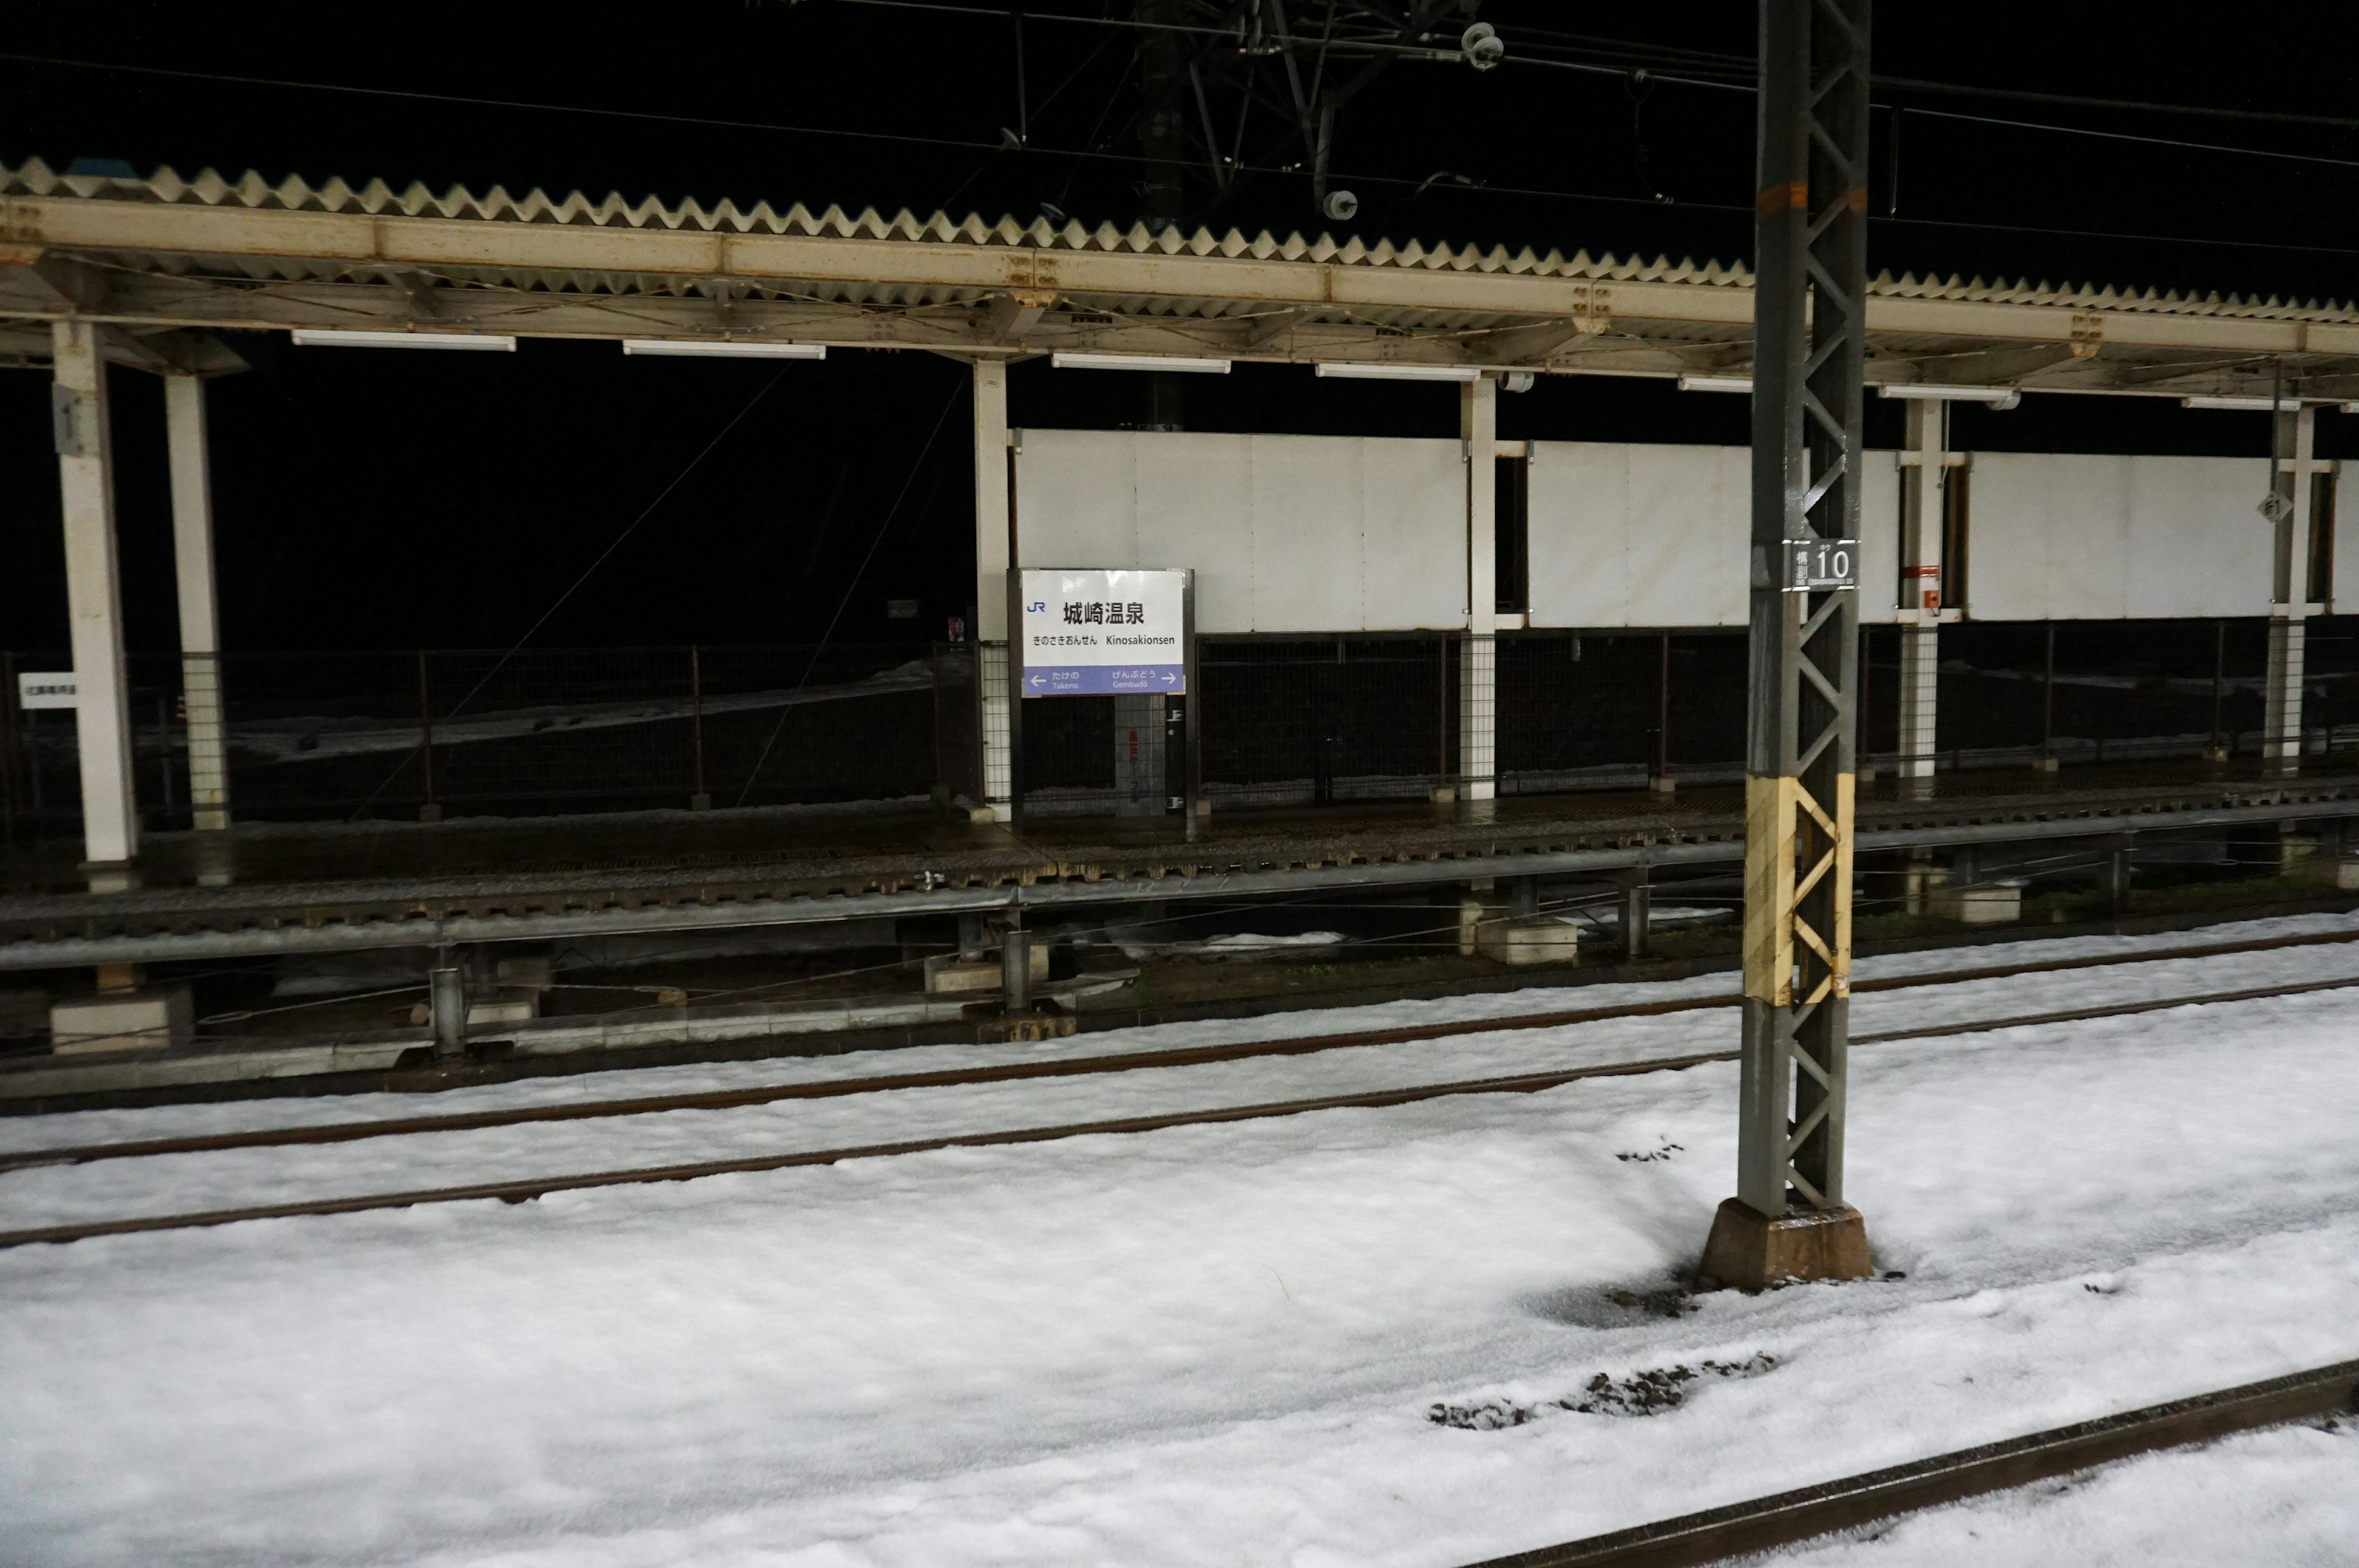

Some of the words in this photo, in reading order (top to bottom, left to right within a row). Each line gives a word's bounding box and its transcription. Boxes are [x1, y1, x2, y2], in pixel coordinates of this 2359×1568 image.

[1818, 551, 1849, 578] 10
[1027, 602, 1046, 612] JR
[1063, 602, 1144, 625] 城崎温泉
[1033, 635, 1098, 646] きのさきおんせん
[1106, 634, 1175, 645] Kinosakionsen
[1052, 671, 1079, 680] たけの
[1113, 669, 1156, 679] げんぶどう
